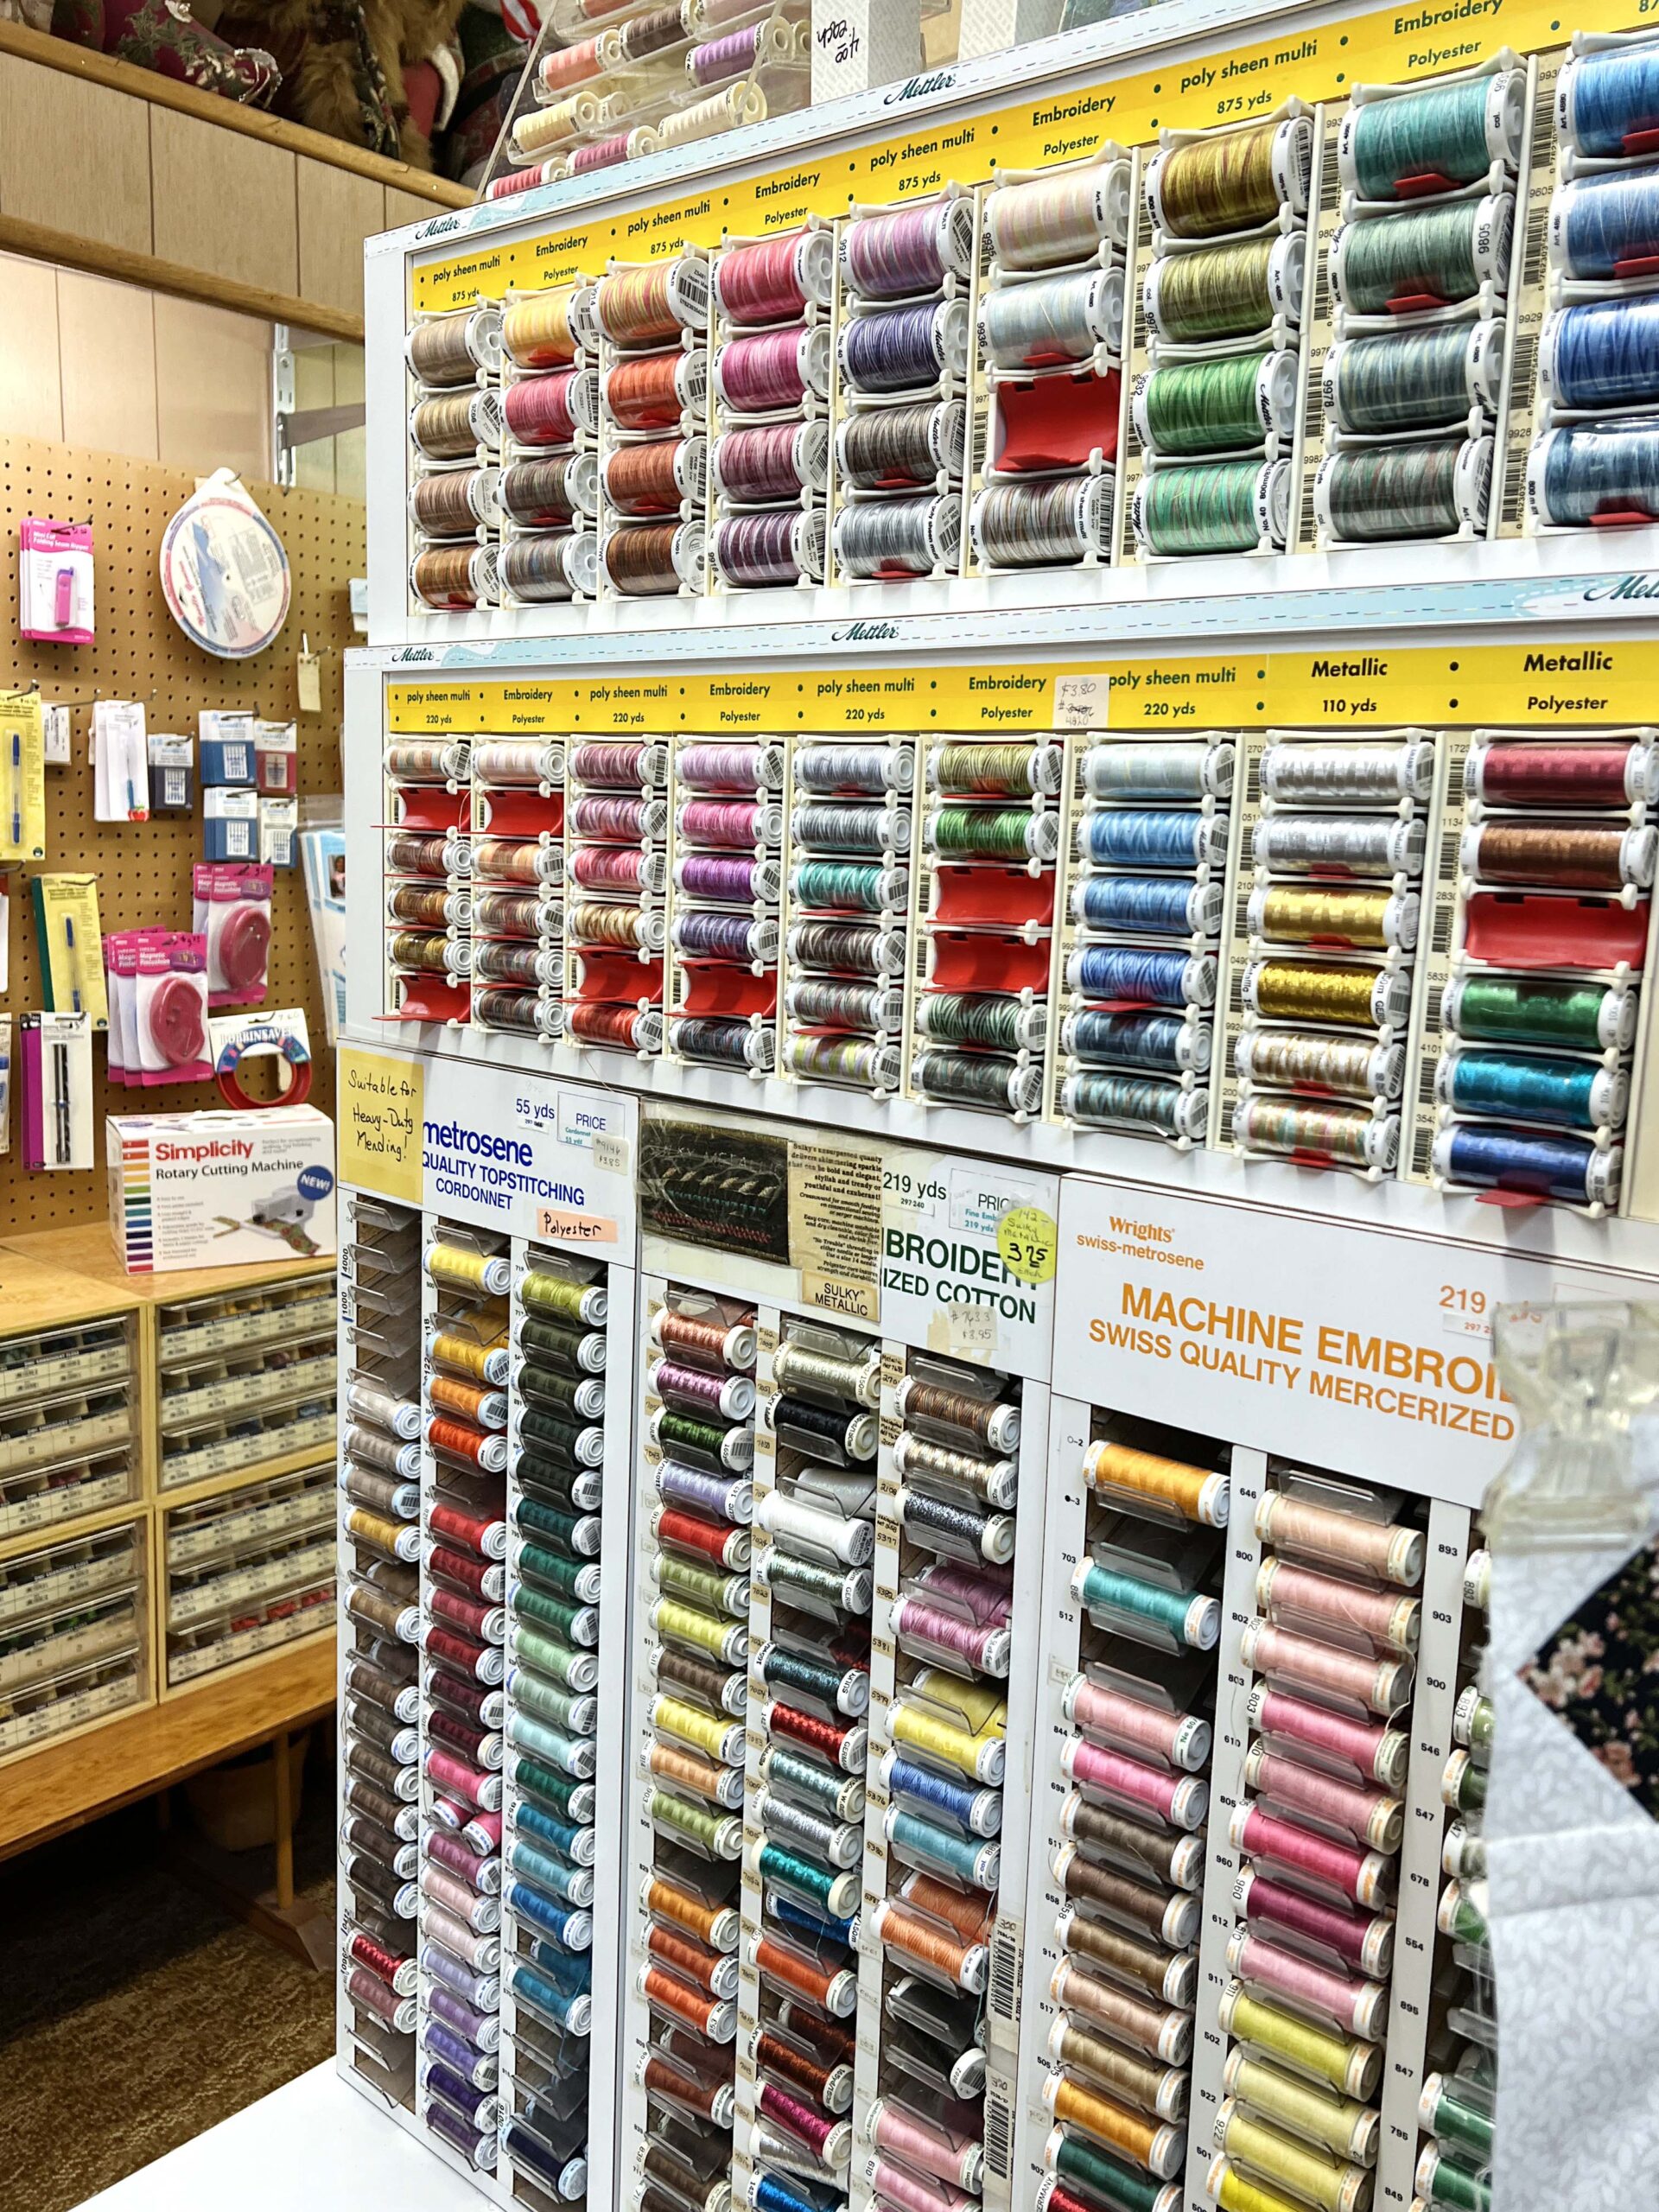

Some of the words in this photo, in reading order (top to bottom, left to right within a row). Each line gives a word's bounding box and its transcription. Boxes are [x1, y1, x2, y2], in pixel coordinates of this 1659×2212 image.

[1395, 0, 1502, 35] Embroidery
[1408, 41, 1481, 67] Polyester
[1180, 68, 1216, 92] poly
[1222, 57, 1268, 79] sheen
[1274, 39, 1318, 65] multi
[884, 73, 956, 105] Mettler
[1033, 96, 1116, 126] Embroidery
[1217, 99, 1243, 115] 875
[1248, 91, 1273, 111] yds
[870, 149, 898, 171] poly
[901, 141, 938, 161] sheen
[942, 128, 975, 150] multi
[1044, 134, 1099, 156] Polyester
[755, 173, 820, 199] Embroidery
[899, 177, 918, 191] 875
[922, 172, 941, 189] yds
[628, 220, 649, 236] poly
[652, 213, 682, 227] sheen
[684, 200, 710, 218] multi
[765, 206, 808, 225] Polyester
[416, 216, 460, 240] Mettler
[536, 236, 588, 257] Embroidery
[651, 242, 666, 254] 875
[669, 237, 684, 252] yds
[1478, 222, 1491, 254] 9805
[839, 239, 848, 264] 9912
[433, 269, 451, 284] poly
[454, 264, 477, 278] sheen
[480, 255, 500, 271] multi
[544, 265, 578, 281] Polyester
[453, 290, 466, 302] 875
[1518, 312, 1543, 324] 9929
[976, 321, 988, 347] 9936
[1323, 379, 1335, 409] 9978
[831, 622, 898, 642] Mettler
[391, 647, 434, 663] Mettler
[1523, 651, 1613, 672] Metallic
[1312, 658, 1388, 677] Metallic
[817, 680, 842, 697] poly
[846, 678, 880, 693] sheen
[884, 677, 915, 692] multi
[969, 675, 1046, 692] Embroidery
[1109, 676, 1139, 691] poly
[1146, 670, 1192, 685] sheen
[1196, 667, 1236, 683] multi
[407, 690, 423, 704] poly
[426, 691, 448, 702] sheen
[450, 690, 470, 702] multi
[504, 689, 553, 702] Embroidery
[590, 689, 610, 702] poly
[613, 687, 641, 698] sheen
[643, 685, 668, 697] multi
[709, 683, 771, 697] Embroidery
[981, 706, 1033, 721] Polyester
[1144, 703, 1168, 715] 220
[1173, 702, 1196, 717] yds
[1322, 699, 1346, 713] 110
[1351, 698, 1377, 715] yds
[1527, 696, 1608, 714] Polyester
[426, 715, 438, 724] 220
[440, 714, 452, 726] yds
[512, 714, 545, 725] Polyester
[613, 713, 628, 723] 220
[630, 712, 645, 725] yds
[720, 711, 760, 724] Polyester
[845, 709, 864, 721] 220
[868, 709, 885, 722] yds
[1421, 1044, 1441, 1053] 4101
[348, 1069, 397, 1096] Suitable
[399, 1080, 416, 1097] for
[353, 1102, 414, 1134] Heavy-Duty
[516, 1098, 531, 1115] 55
[534, 1101, 556, 1121] yds
[575, 1112, 607, 1132] PRICE
[156, 1139, 254, 1162] Simplicity
[357, 1129, 408, 1162] Mending!
[423, 1121, 532, 1166] metrosene
[156, 1166, 199, 1180] Rotary
[201, 1162, 248, 1178] Cutting
[251, 1158, 304, 1173] Machine
[300, 1173, 330, 1192] NEW!
[423, 1150, 476, 1179] QUALITY
[480, 1166, 585, 1206] TOPSTITCHING
[883, 1172, 912, 1193] 219
[917, 1179, 947, 1201] yds
[436, 1178, 513, 1211] CORDONNET
[978, 1193, 1011, 1211] PRIC
[543, 1211, 602, 1237] Polyester
[1109, 1215, 1173, 1243] Wrights
[1076, 1234, 1205, 1270] swiss-metrosene
[823, 1282, 860, 1302] SULKY
[880, 1268, 930, 1297] IZED
[936, 1280, 1036, 1324] COTTON
[1438, 1284, 1486, 1314] 219
[815, 1292, 868, 1317] METALLIC
[1121, 1281, 1304, 1357] MACHINE
[1089, 1318, 1172, 1359] SWISS
[1179, 1339, 1301, 1390] QUALITY
[1308, 1374, 1515, 1442] MERCERIZED
[1240, 1487, 1257, 1499] 646
[1236, 1550, 1253, 1562] 800
[1438, 1543, 1459, 1556] 893
[1062, 1553, 1077, 1564] 703
[1058, 1611, 1073, 1622] 512
[1231, 1612, 1249, 1624] 802
[1432, 1610, 1452, 1624] 903
[1426, 1676, 1446, 1690] 900
[1246, 1693, 1260, 1713] 803
[1053, 1725, 1068, 1737] 844
[1224, 1735, 1241, 1748] 610
[1421, 1741, 1440, 1756] 546
[1051, 1782, 1065, 1794] 698
[1219, 1796, 1236, 1808] 805
[1415, 1808, 1435, 1822] 547
[1216, 1855, 1233, 1868] 960
[1410, 1872, 1429, 1888] 678
[1046, 1892, 1059, 1905] 658
[1211, 1914, 1229, 1928] 612
[1405, 1936, 1424, 1952] 554
[1042, 1948, 1057, 1960] 914
[1208, 1972, 1224, 1986] 911
[1039, 2002, 1054, 2015] 517
[1400, 2000, 1419, 2016] 895
[1204, 2031, 1221, 2045] 502
[1037, 2056, 1052, 2069] 505
[1395, 2063, 1414, 2078] 847
[1200, 2088, 1217, 2104] 922
[1212, 2118, 1225, 2142] 922
[1390, 2126, 1408, 2141] 795
[1196, 2146, 1211, 2160] 501
[1384, 2187, 1403, 2202] 849
